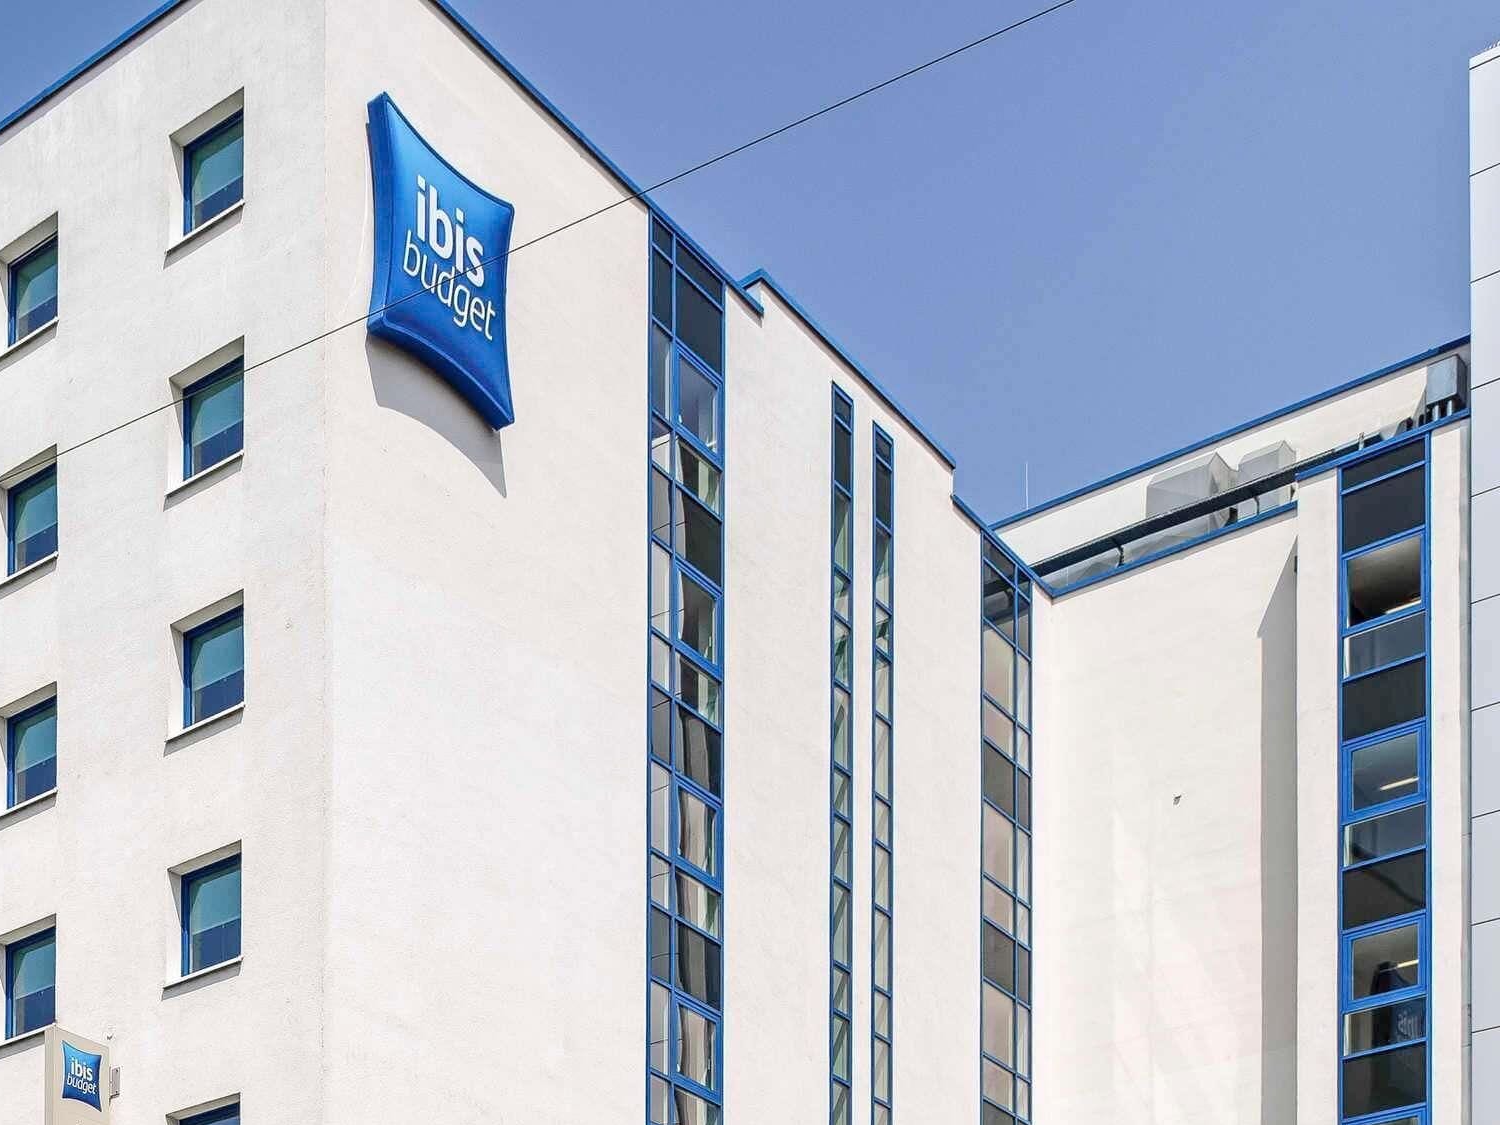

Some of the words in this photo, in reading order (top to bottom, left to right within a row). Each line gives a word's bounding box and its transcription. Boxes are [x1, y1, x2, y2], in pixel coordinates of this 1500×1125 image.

[415, 174, 485, 288] ibis
[402, 229, 497, 341] budget
[66, 1073, 97, 1096] budget
[70, 1056, 94, 1083] ibis
